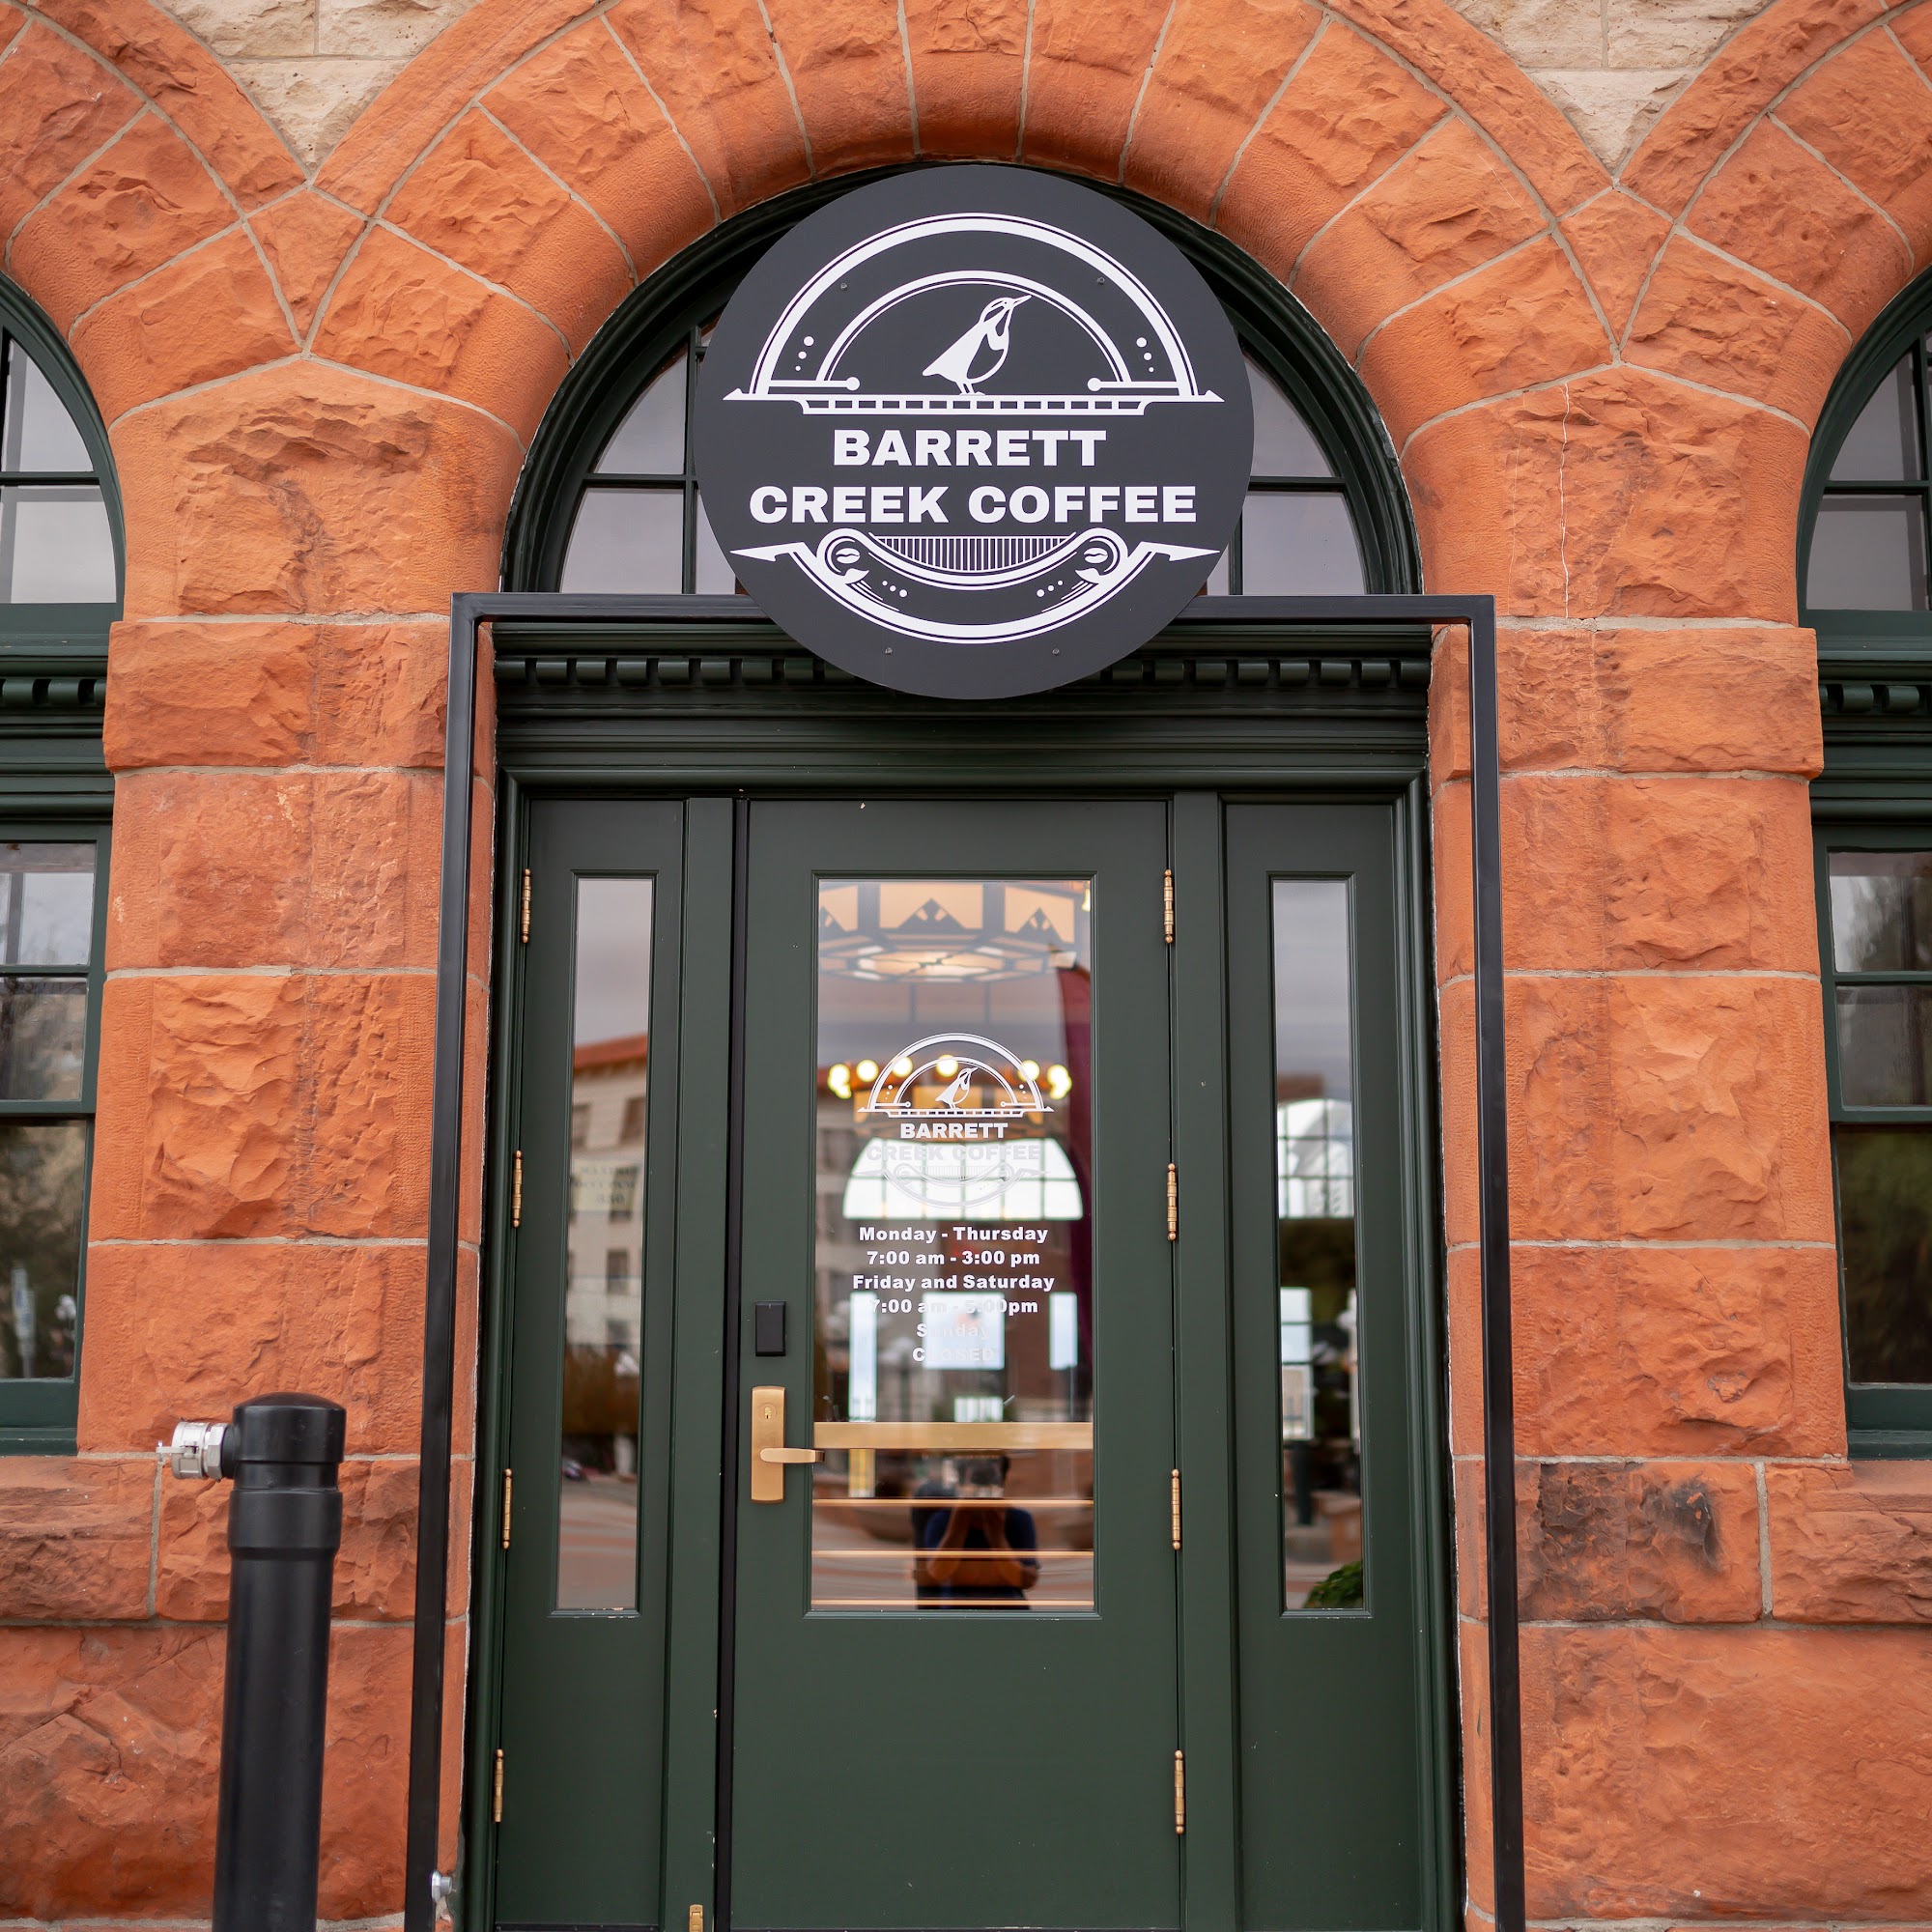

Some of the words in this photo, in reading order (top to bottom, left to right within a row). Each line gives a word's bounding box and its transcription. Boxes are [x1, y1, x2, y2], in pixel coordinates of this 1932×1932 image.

[834, 429, 1106, 467] BARRETT
[749, 485, 949, 524] CREEK
[968, 485, 1197, 524] COFFEE
[900, 1122, 1009, 1139] BARRETT
[866, 1145, 944, 1161] CREEK
[952, 1145, 1041, 1161] COFFEE
[859, 1227, 937, 1243] Monday
[952, 1226, 1049, 1243] Thursday
[867, 1251, 910, 1265] 7:00
[915, 1254, 945, 1265] am
[961, 1250, 1006, 1265] 3:00
[1010, 1254, 1040, 1267] pm
[852, 1275, 916, 1292] Friday
[921, 1275, 957, 1290] and
[963, 1274, 1055, 1293] Saturday
[871, 1298, 913, 1314] 7:00
[917, 1302, 948, 1314] am
